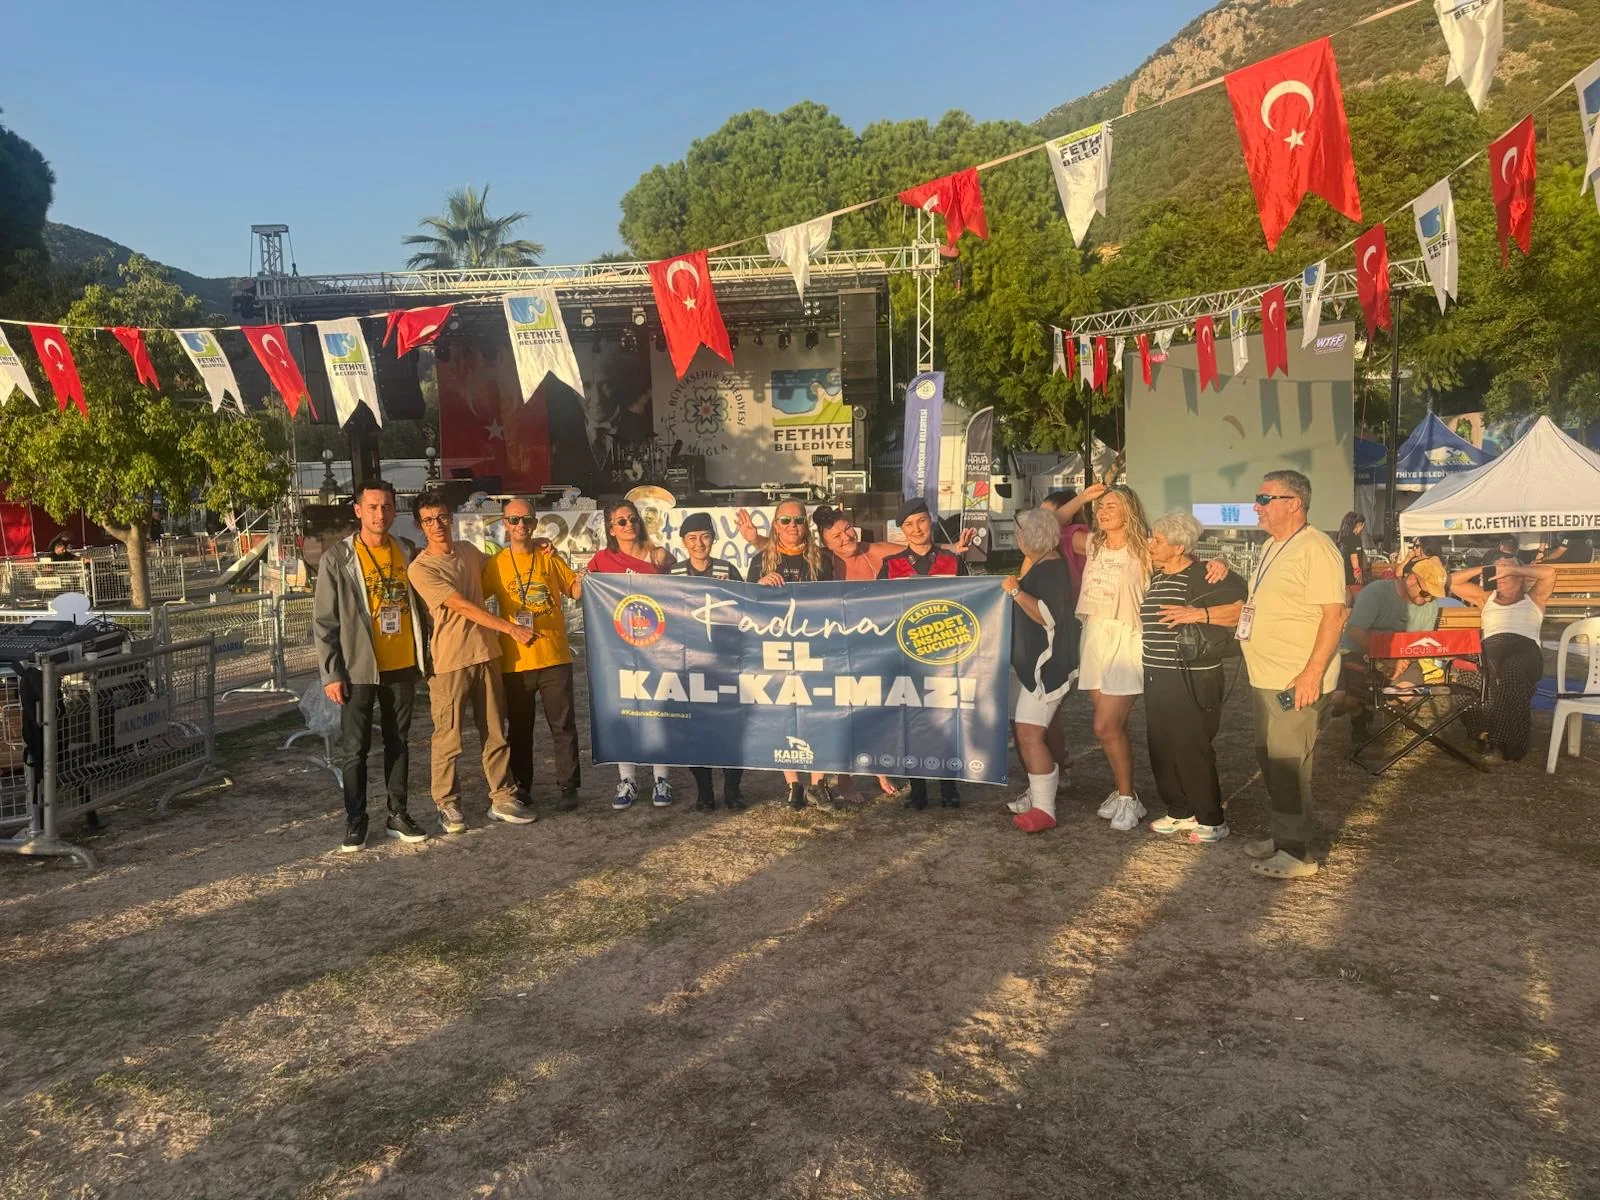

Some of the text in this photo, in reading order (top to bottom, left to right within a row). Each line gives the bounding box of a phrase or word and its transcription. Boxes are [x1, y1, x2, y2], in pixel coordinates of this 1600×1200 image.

[908, 605, 950, 624] KADINA
[763, 641, 824, 671] EL
[1400, 646, 1432, 655] FOCUS
[618, 669, 977, 710] KAL-KA-MAZ!
[774, 749, 814, 760] KADES
